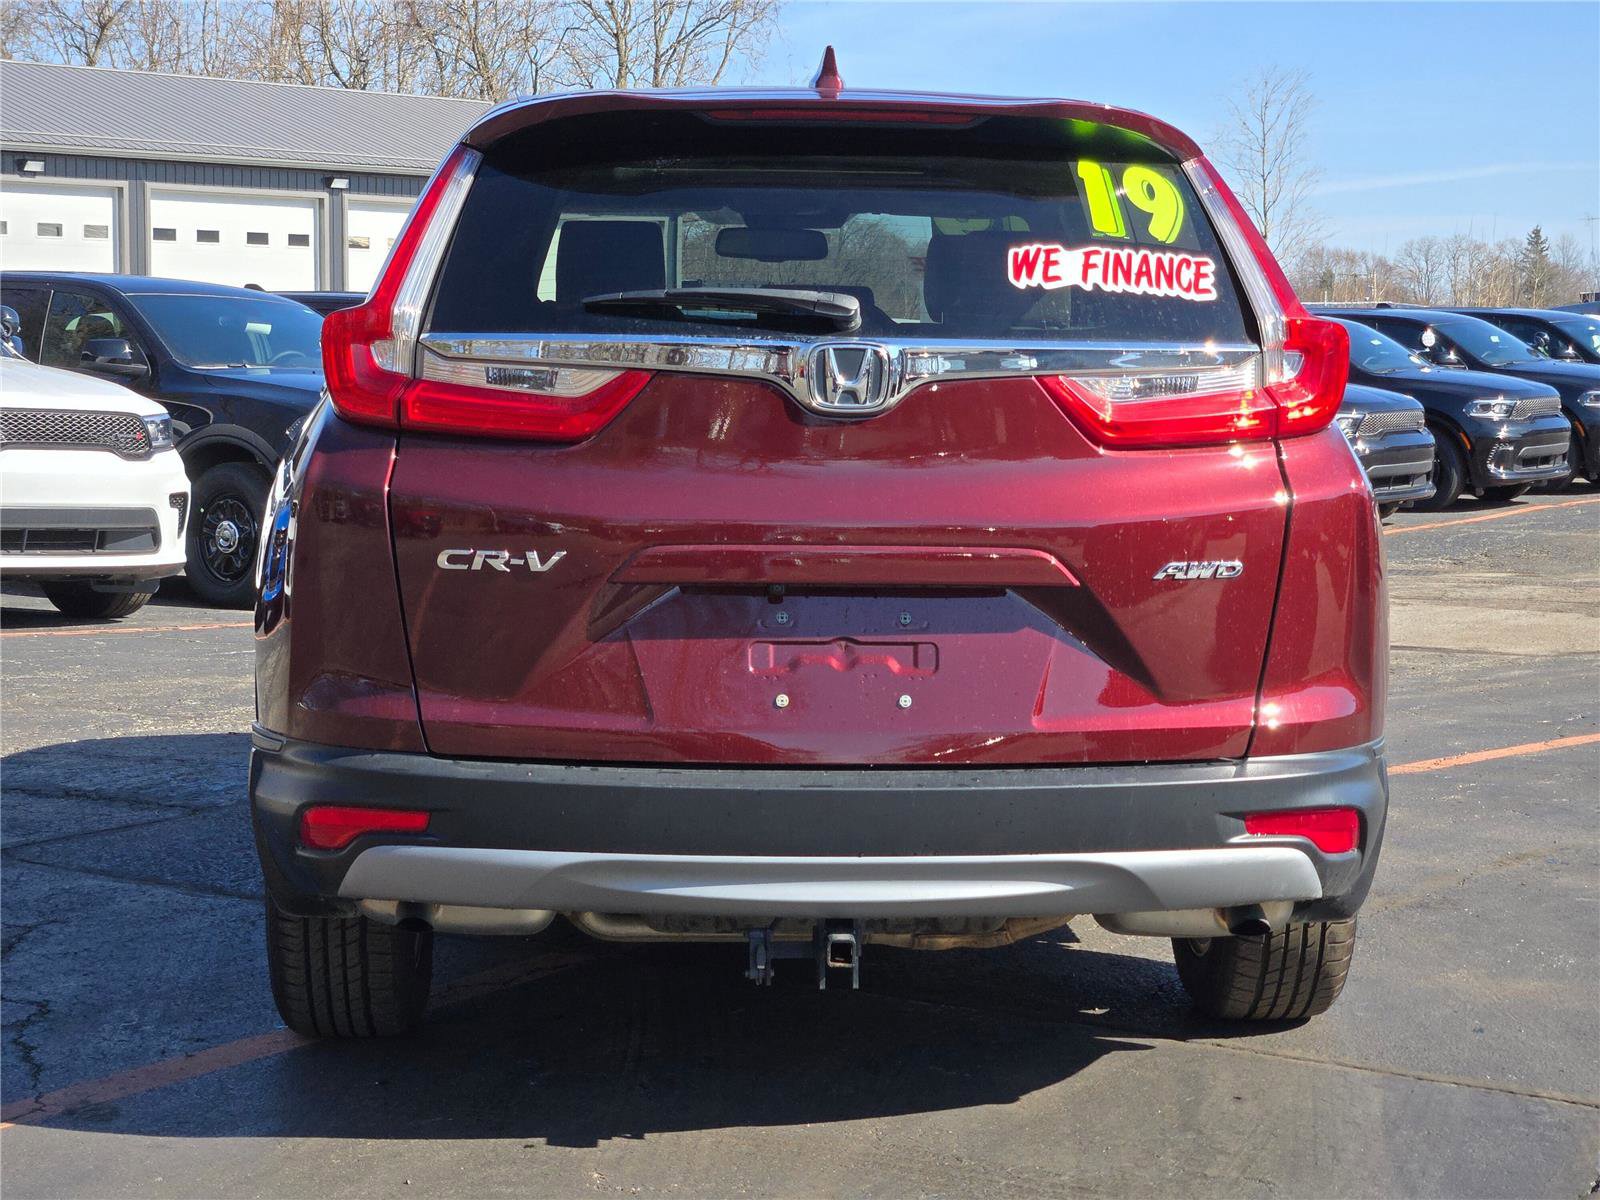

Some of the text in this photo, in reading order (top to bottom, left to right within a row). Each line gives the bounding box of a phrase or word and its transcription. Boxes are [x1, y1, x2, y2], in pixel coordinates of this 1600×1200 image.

[1077, 159, 1184, 243] 19
[1010, 246, 1214, 296] WE FINANCE
[436, 548, 567, 573] CR-V
[1152, 559, 1244, 580] AWD
